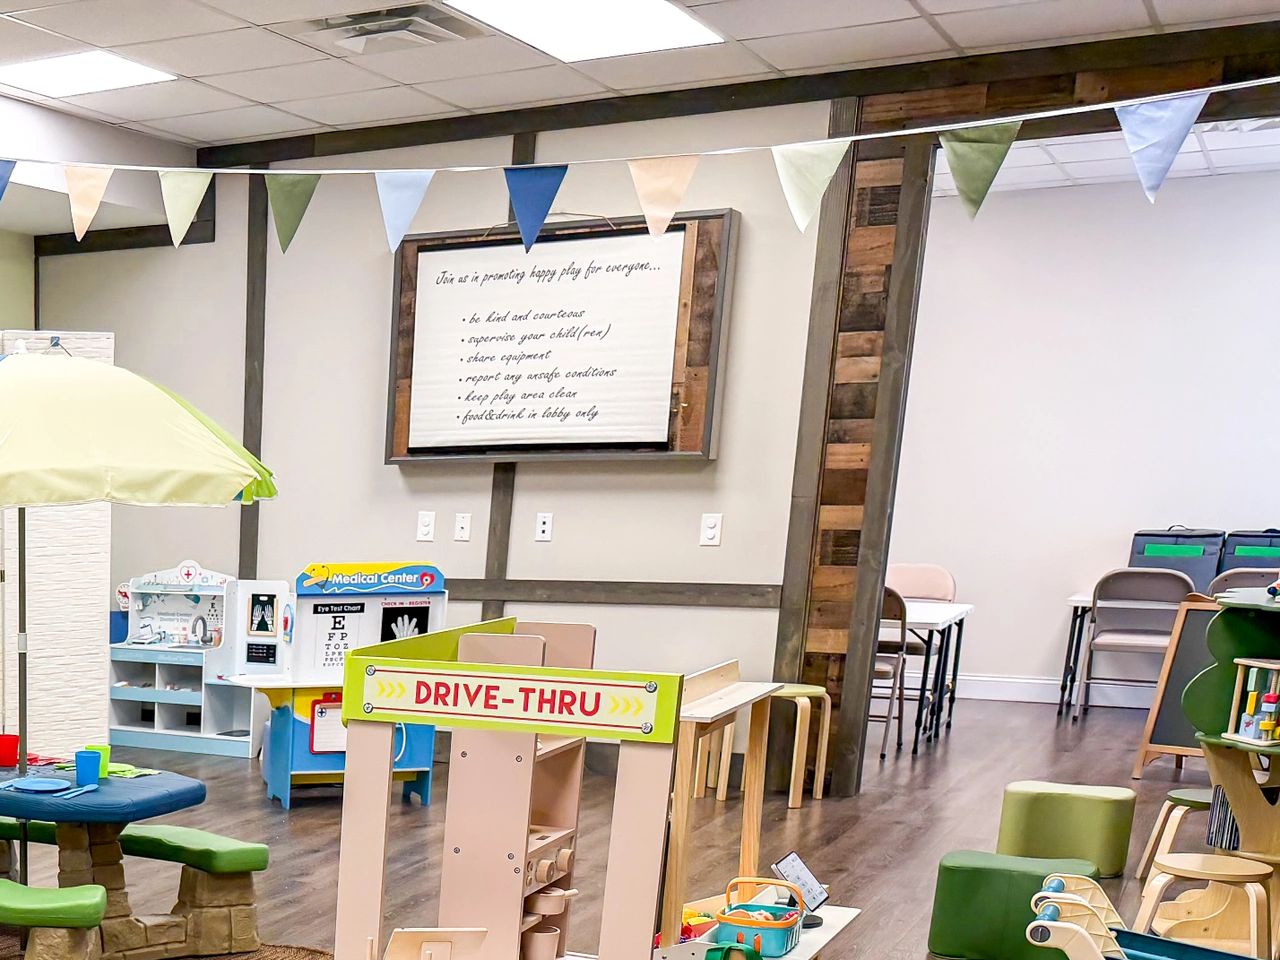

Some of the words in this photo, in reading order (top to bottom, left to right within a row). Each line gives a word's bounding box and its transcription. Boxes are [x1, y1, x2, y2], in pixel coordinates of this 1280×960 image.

[436, 270, 454, 285] Join
[458, 274, 469, 283] us
[471, 272, 479, 282] in
[480, 268, 526, 286] promoting
[529, 265, 556, 282] happy
[558, 262, 581, 281] play
[585, 260, 602, 280] for
[469, 313, 480, 324] be
[485, 311, 510, 323] kind
[512, 310, 532, 321] and
[533, 309, 585, 320] courteous
[468, 332, 516, 347] supervise
[518, 333, 545, 346] your
[550, 324, 611, 341] child(ren)
[467, 352, 496, 363] share
[500, 350, 552, 365] equipment
[465, 372, 501, 386] report
[504, 373, 522, 384] any
[527, 367, 560, 383] unsafe
[565, 366, 617, 378] conditions
[464, 390, 489, 405] keep
[490, 389, 516, 404] play
[520, 391, 544, 400] area
[549, 386, 578, 398] clean
[462, 408, 524, 425] food&drink
[528, 410, 536, 419] in
[542, 407, 571, 422] lobby
[575, 406, 599, 421] only
[332, 572, 377, 584] Medical
[381, 573, 418, 583] Center
[331, 616, 345, 630] E
[414, 680, 601, 716] DRIVE-THRU
